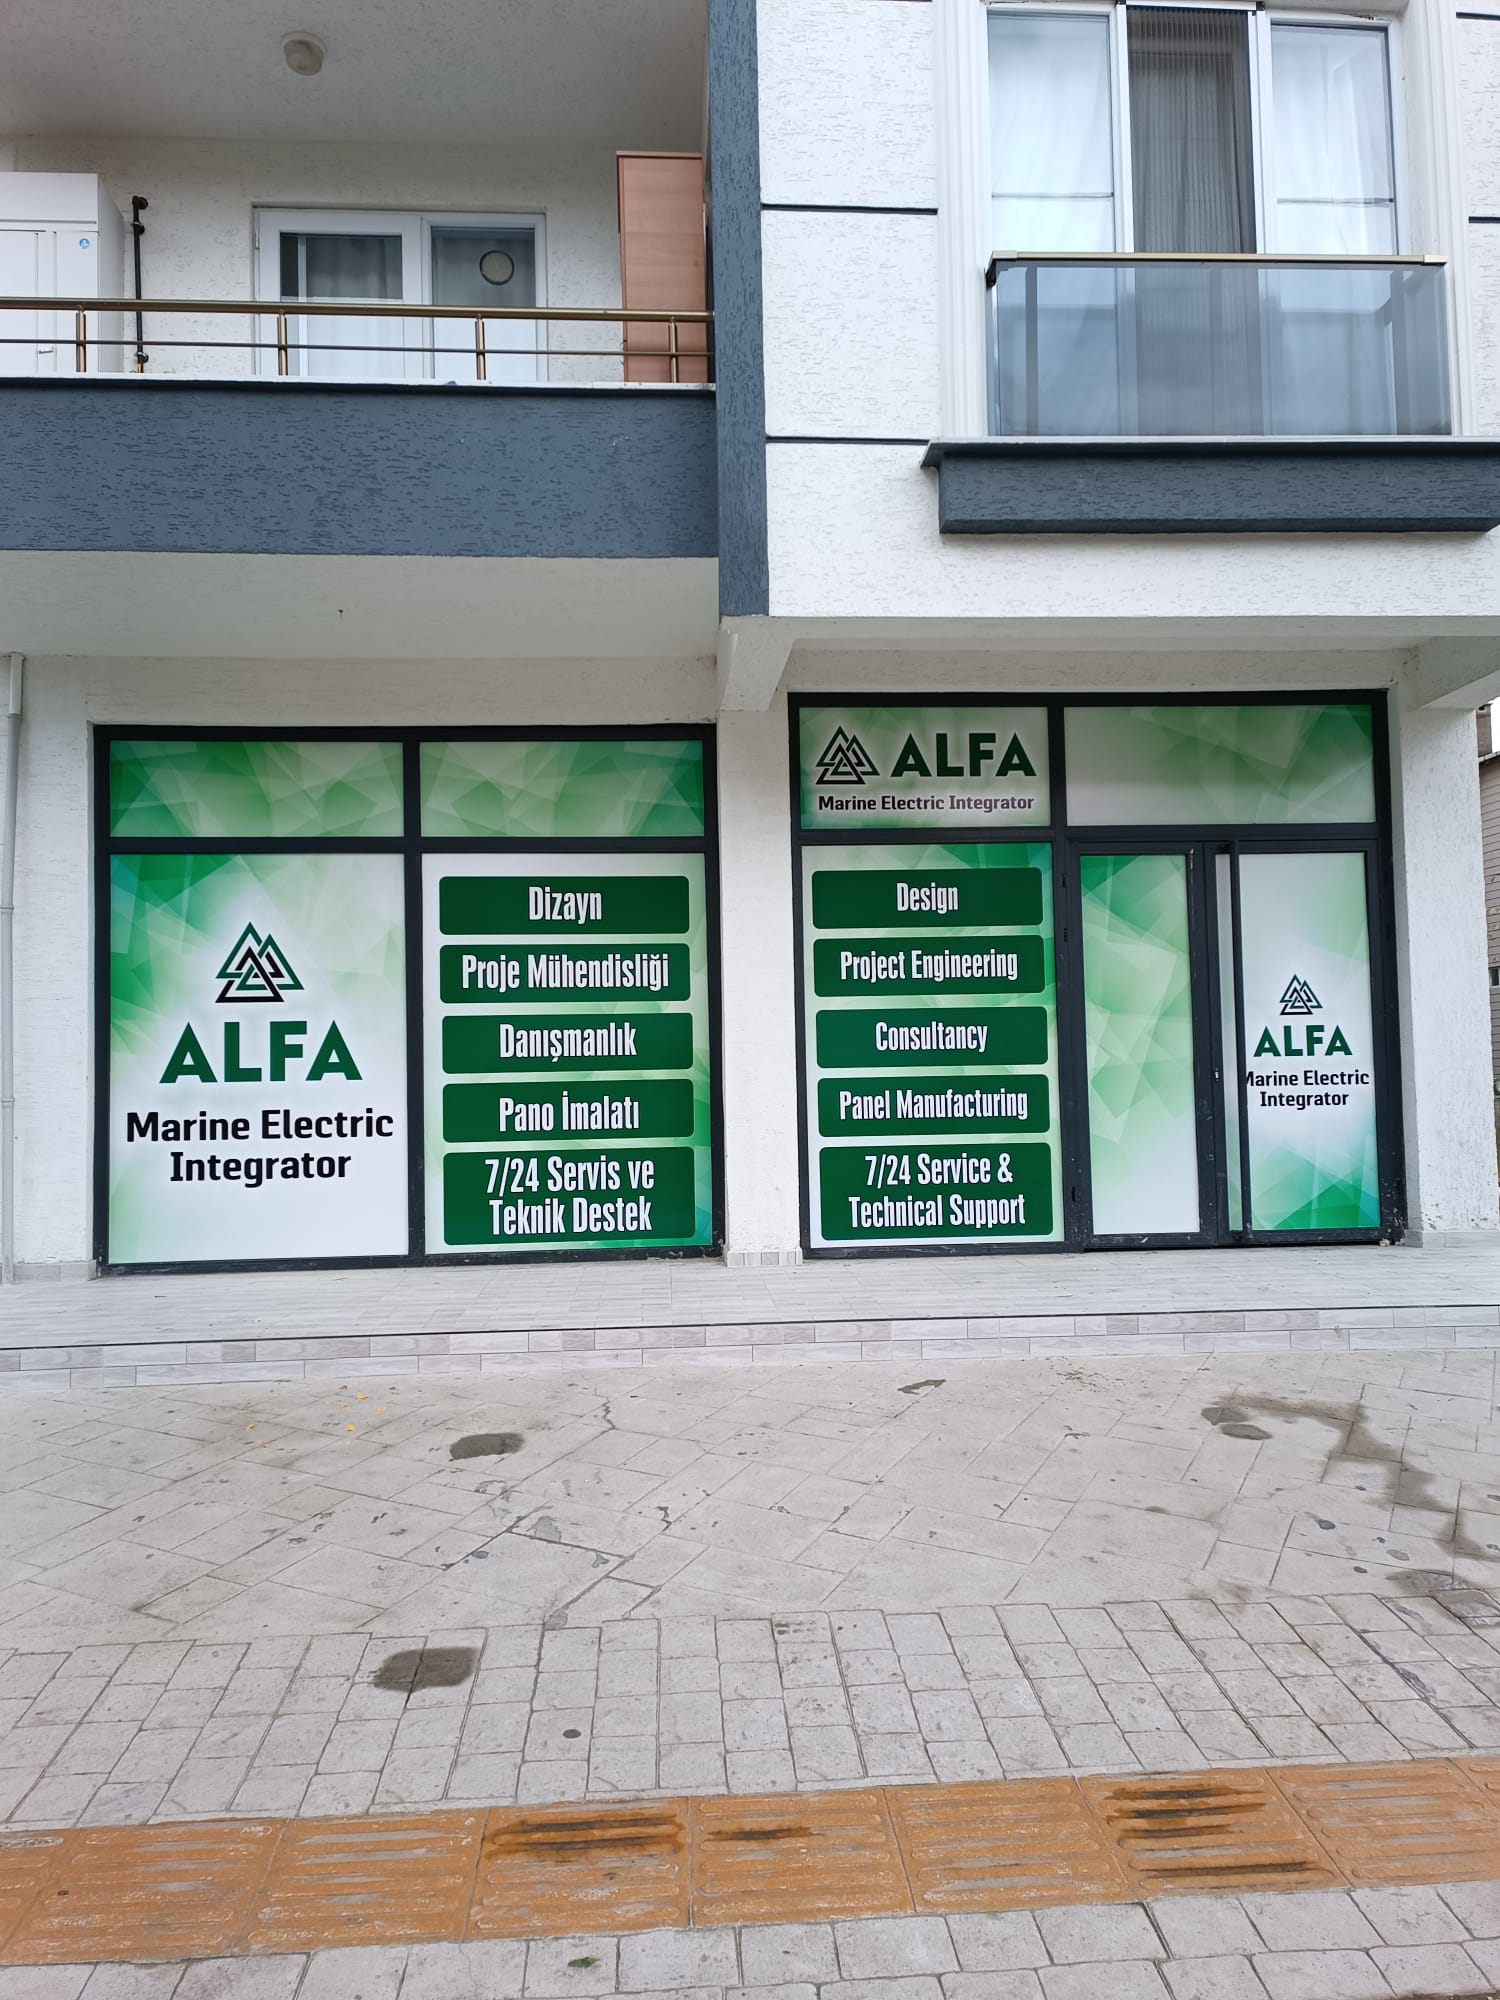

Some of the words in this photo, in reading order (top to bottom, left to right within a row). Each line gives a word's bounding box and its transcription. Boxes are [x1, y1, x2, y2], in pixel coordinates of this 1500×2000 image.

[890, 733, 1037, 777] ALFA
[819, 796, 876, 811] Marine
[881, 795, 944, 810] Electric
[949, 795, 1034, 813] Integrator
[528, 886, 602, 925] Dizayn
[896, 882, 959, 913] Design
[461, 955, 520, 993] Proje
[527, 953, 669, 991] Mühendisliği
[840, 951, 906, 982] Project
[911, 949, 1018, 981] Engineering
[159, 1020, 363, 1083] ALFA
[499, 1023, 637, 1062] Danışmanlık
[875, 1021, 988, 1053] Consultancy
[1253, 1025, 1353, 1057] ALFA
[1304, 1069, 1370, 1086] Electric
[499, 1098, 554, 1132] Pano
[562, 1091, 640, 1130] İmalatı
[839, 1090, 890, 1121] Panel
[896, 1088, 1028, 1120] Manufacturing
[1260, 1091, 1349, 1110] Integrator
[127, 1111, 250, 1142] Marine
[261, 1107, 394, 1139] Electric
[170, 1152, 351, 1188] Integrator
[485, 1157, 540, 1197] 7/24
[547, 1155, 621, 1192] Servis
[628, 1159, 655, 1189] ve
[865, 1154, 911, 1189] 7/24
[917, 1153, 991, 1185] Service
[998, 1153, 1013, 1183] &
[489, 1198, 565, 1235] Teknik
[573, 1196, 652, 1233] Destek
[849, 1195, 943, 1228] Technical
[949, 1194, 1026, 1228] Support
